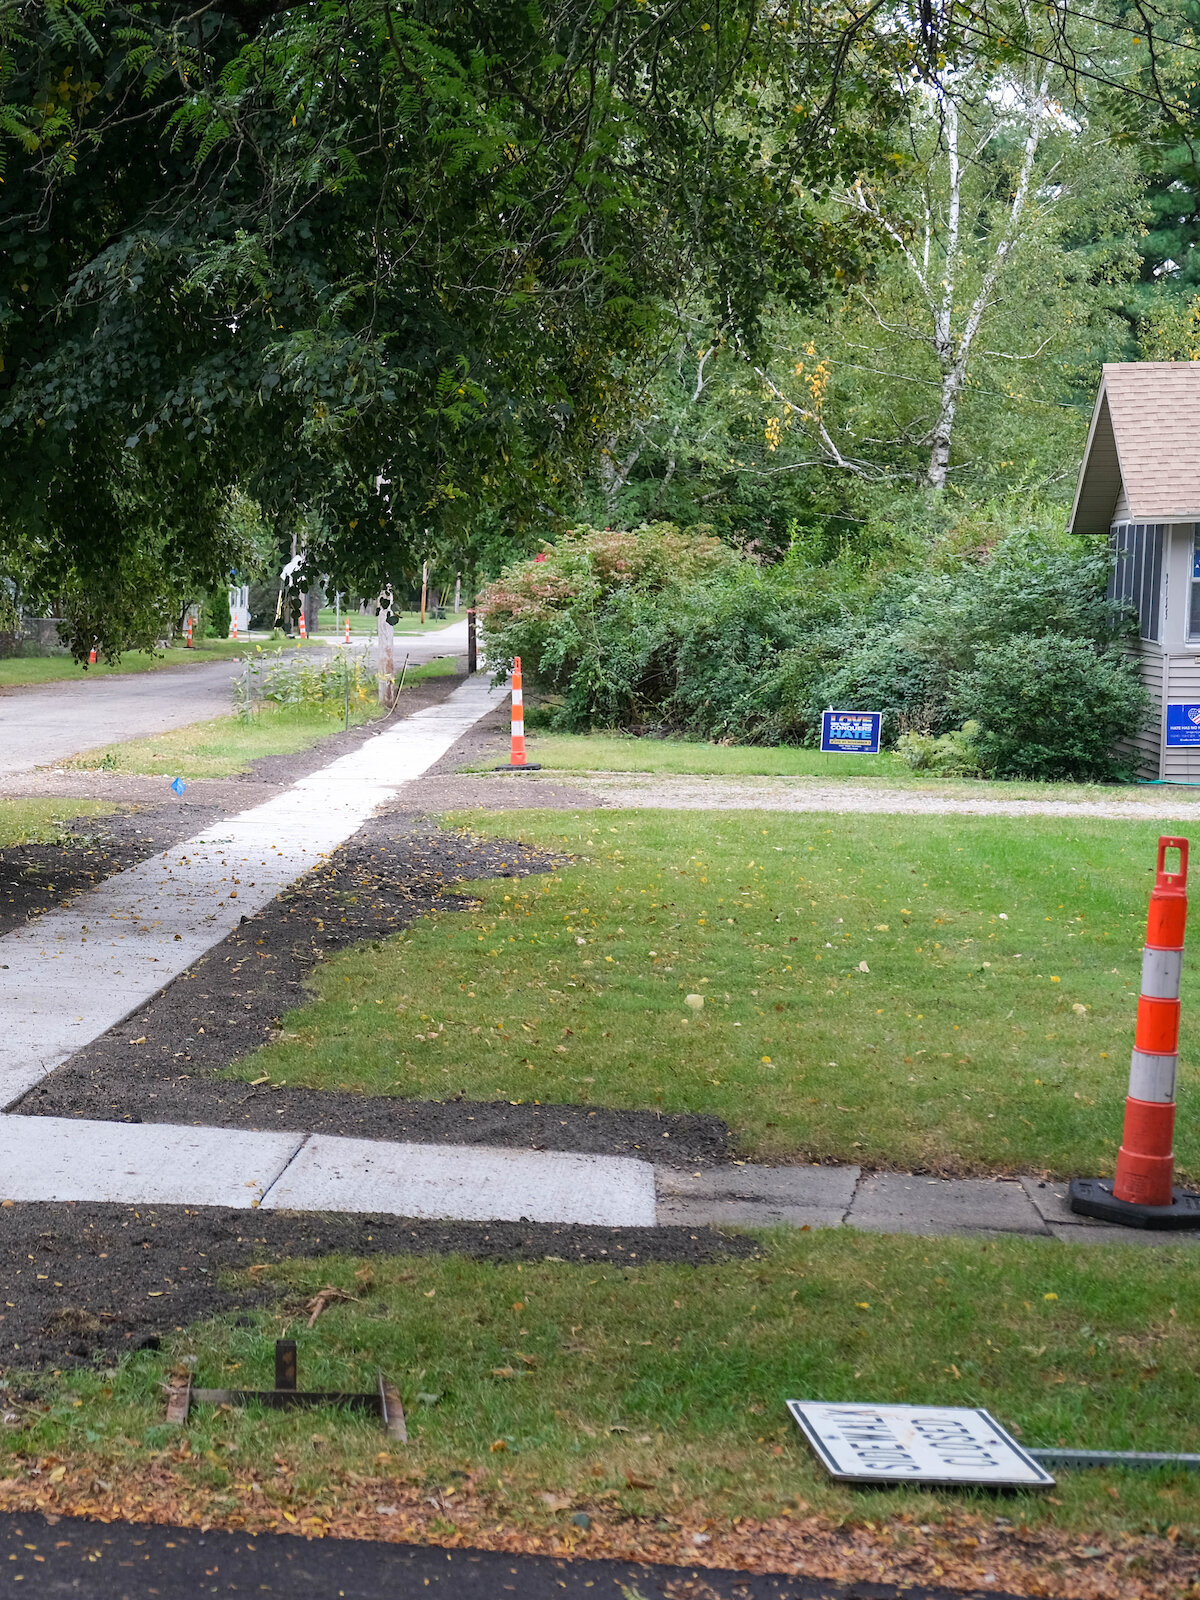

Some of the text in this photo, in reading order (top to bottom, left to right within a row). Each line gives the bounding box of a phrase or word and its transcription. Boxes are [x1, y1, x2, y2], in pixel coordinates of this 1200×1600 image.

[830, 715, 873, 726] LOVE
[830, 730, 872, 739] HATE
[910, 1419, 999, 1467] CLOSED
